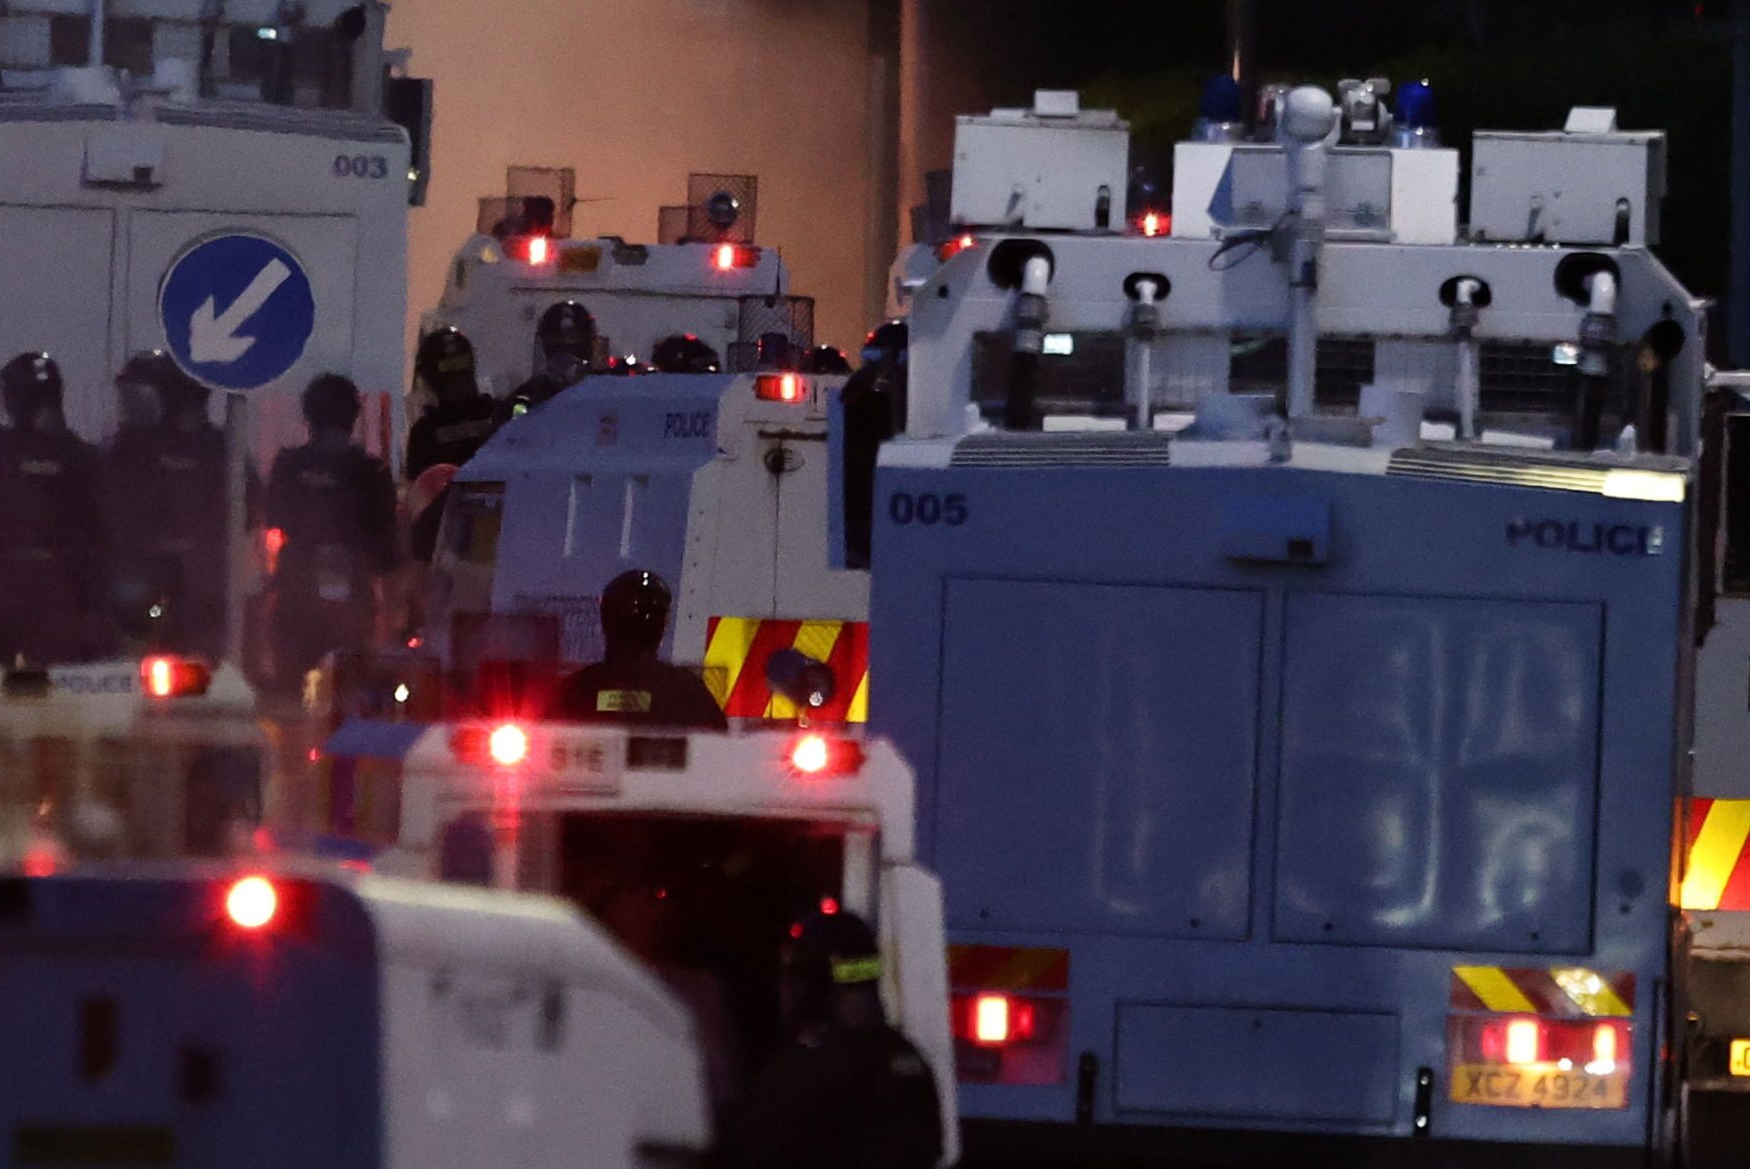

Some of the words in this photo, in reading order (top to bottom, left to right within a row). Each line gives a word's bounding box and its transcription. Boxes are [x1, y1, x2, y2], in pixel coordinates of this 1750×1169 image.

[334, 155, 387, 179] 003
[665, 412, 710, 439] POLICE
[890, 492, 968, 526] 005
[1506, 519, 1664, 556] POLICE
[1467, 1070, 1522, 1099] XCZ
